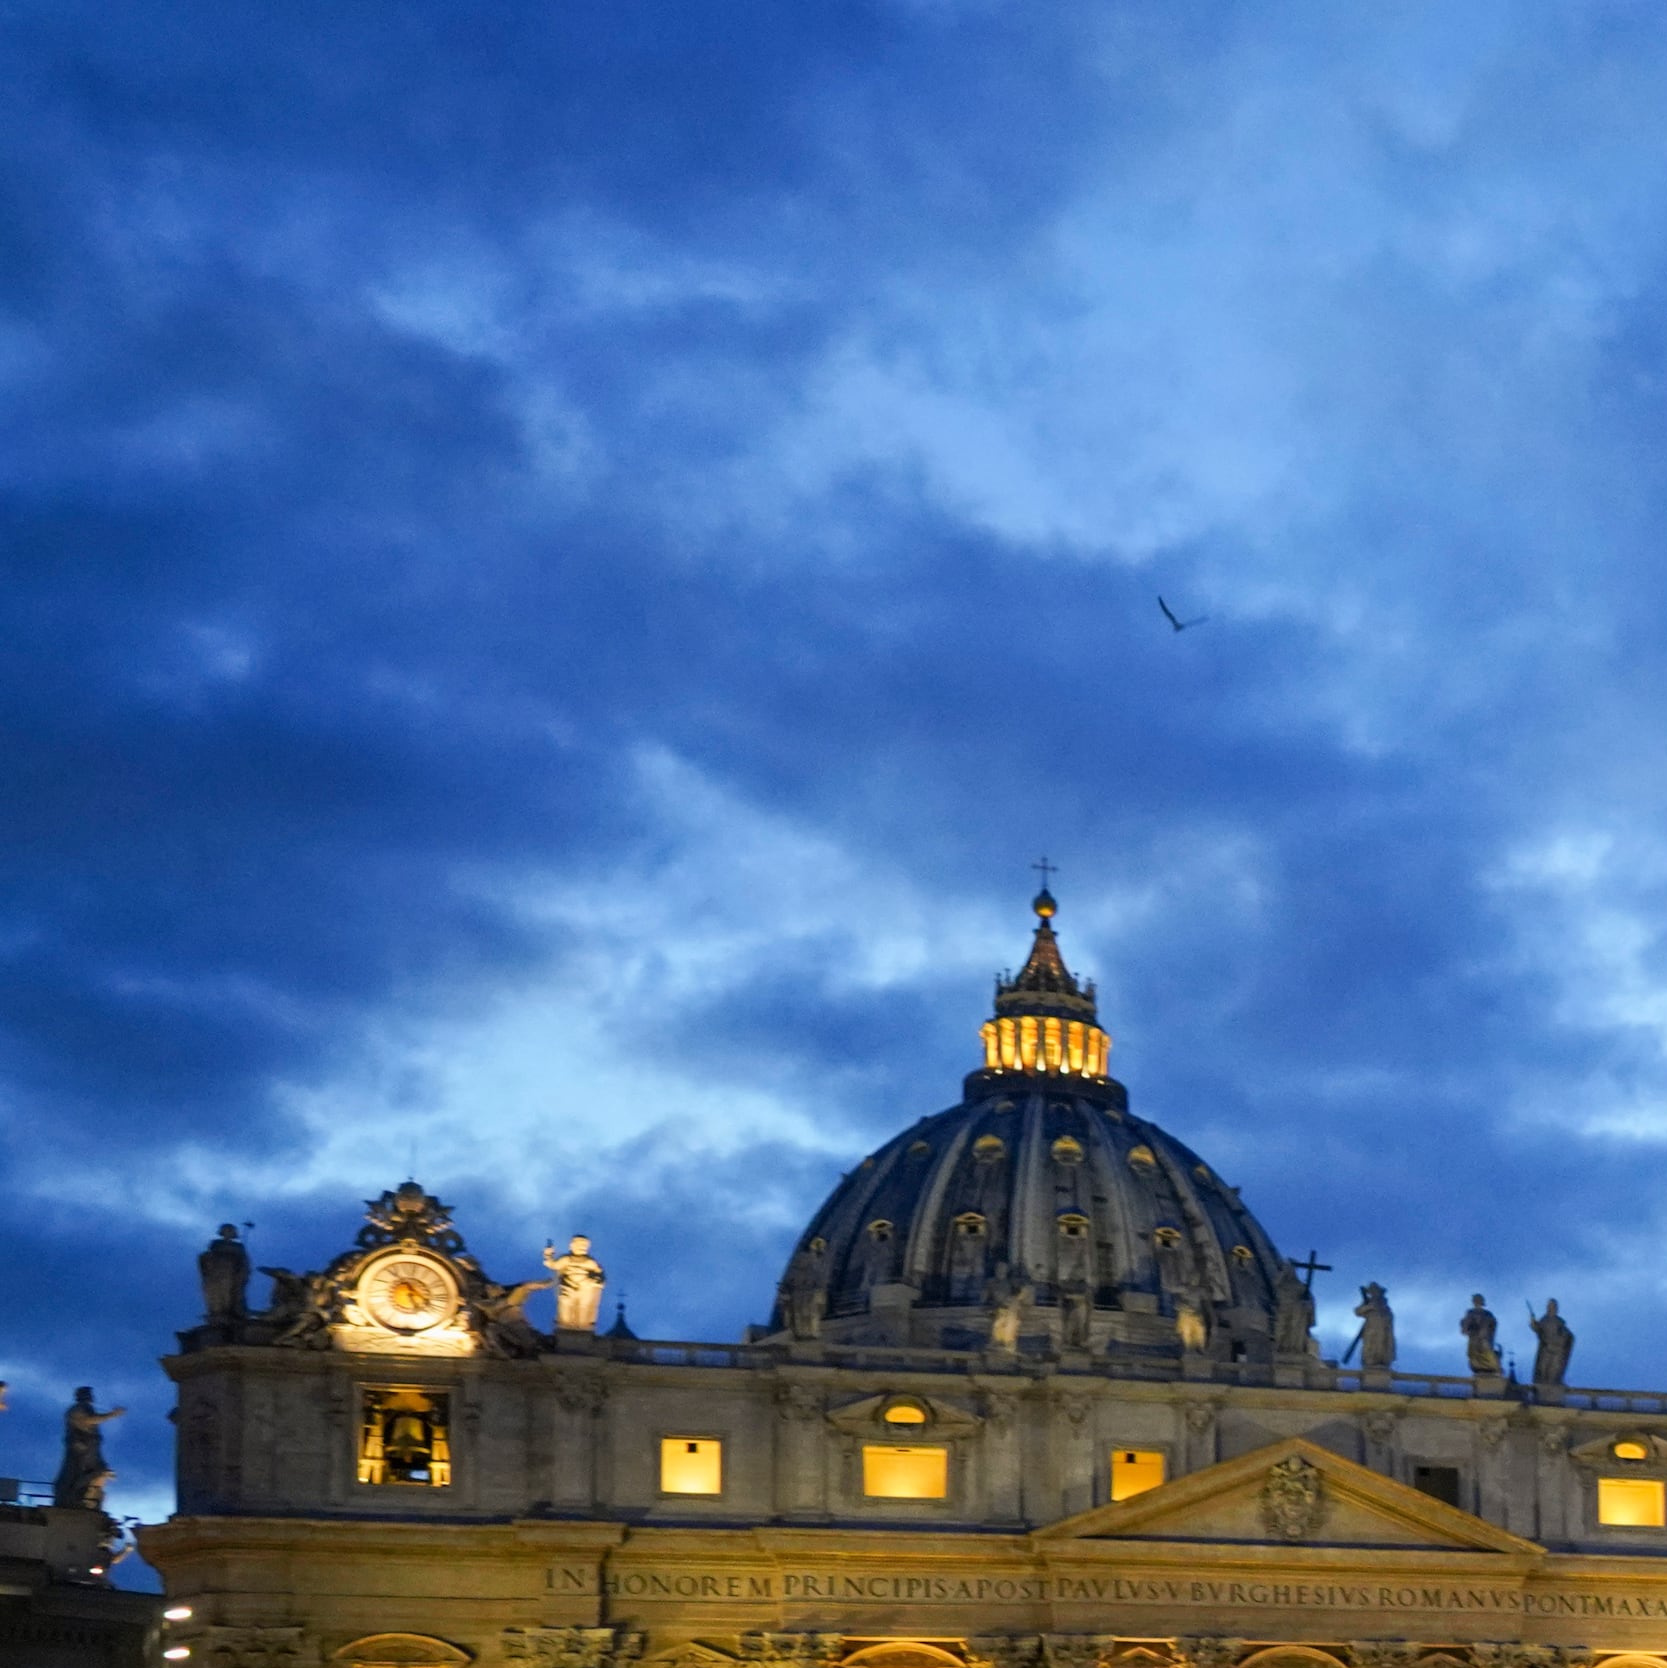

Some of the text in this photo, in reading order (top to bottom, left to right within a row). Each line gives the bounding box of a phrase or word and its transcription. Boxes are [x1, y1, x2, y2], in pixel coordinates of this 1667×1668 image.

[546, 1567, 585, 1590] IN
[784, 1574, 948, 1599] PRINCIPIS
[1190, 1582, 1371, 1606] BVRGHESIVS
[1379, 1587, 1520, 1609] ROMANVS
